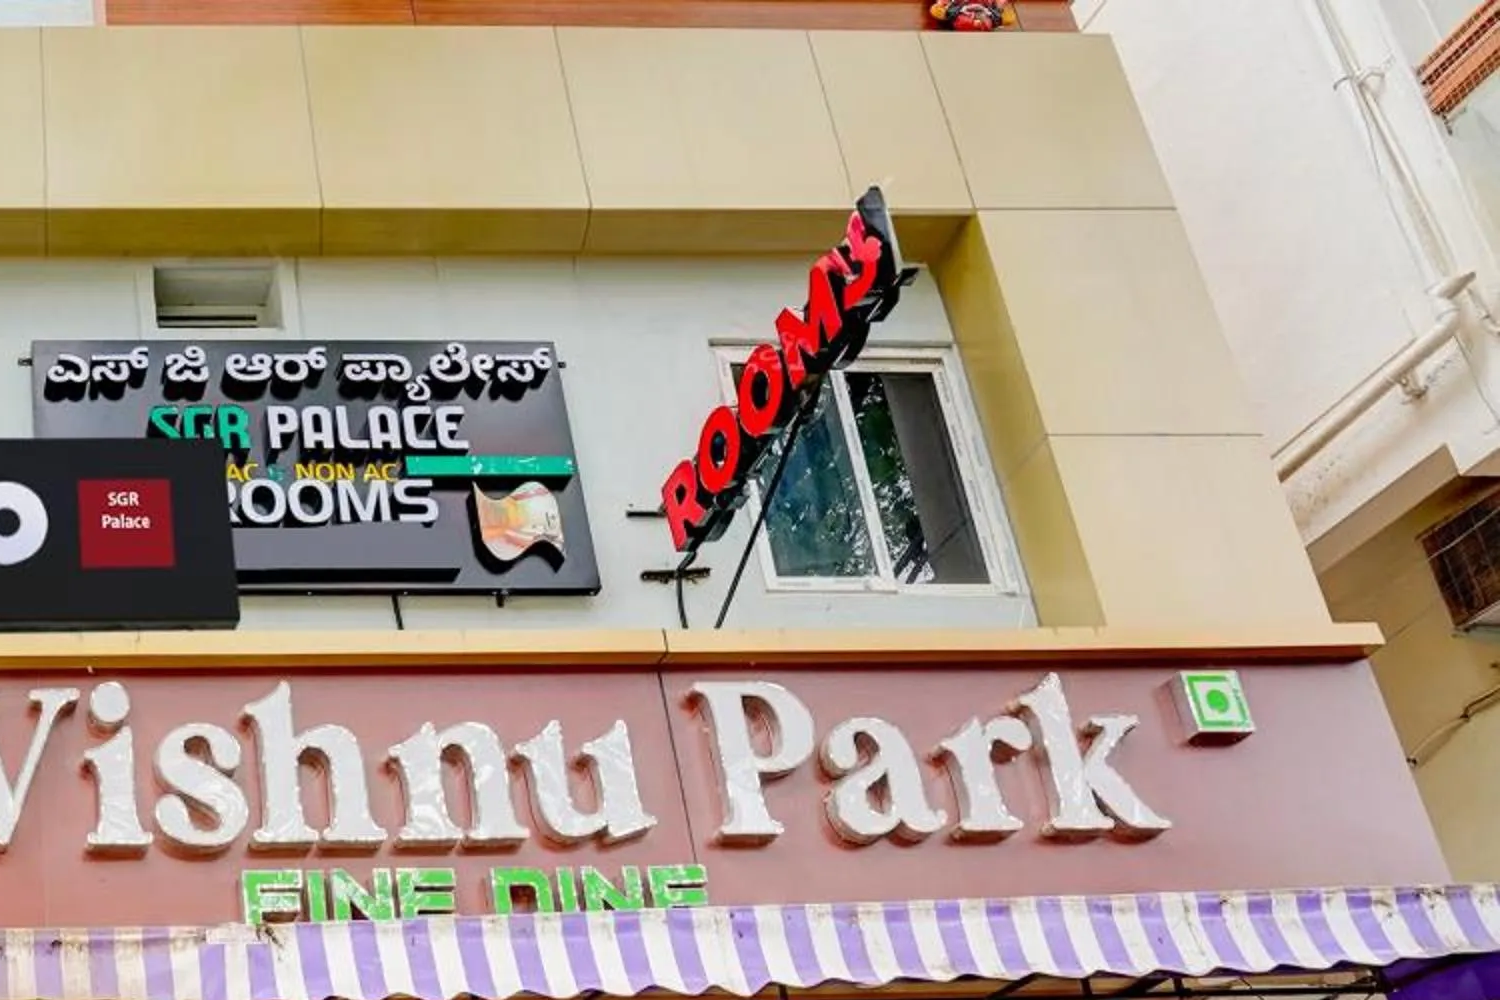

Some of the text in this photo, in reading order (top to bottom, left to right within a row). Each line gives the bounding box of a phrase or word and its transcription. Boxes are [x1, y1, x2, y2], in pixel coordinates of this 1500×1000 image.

[47, 342, 552, 401] ಎಸ್ ಜಿ ಆರ್ ಪ್ಯಾಲೇಸ್
[661, 210, 882, 552] ROOMS
[149, 405, 471, 449] SGR PALACE
[226, 463, 259, 482] AC
[294, 463, 356, 482] NON
[363, 463, 399, 482] AC
[101, 514, 151, 530] Palace
[107, 491, 140, 507] SGR
[690, 671, 1174, 846] Park
[241, 863, 708, 925] FINE DINE
